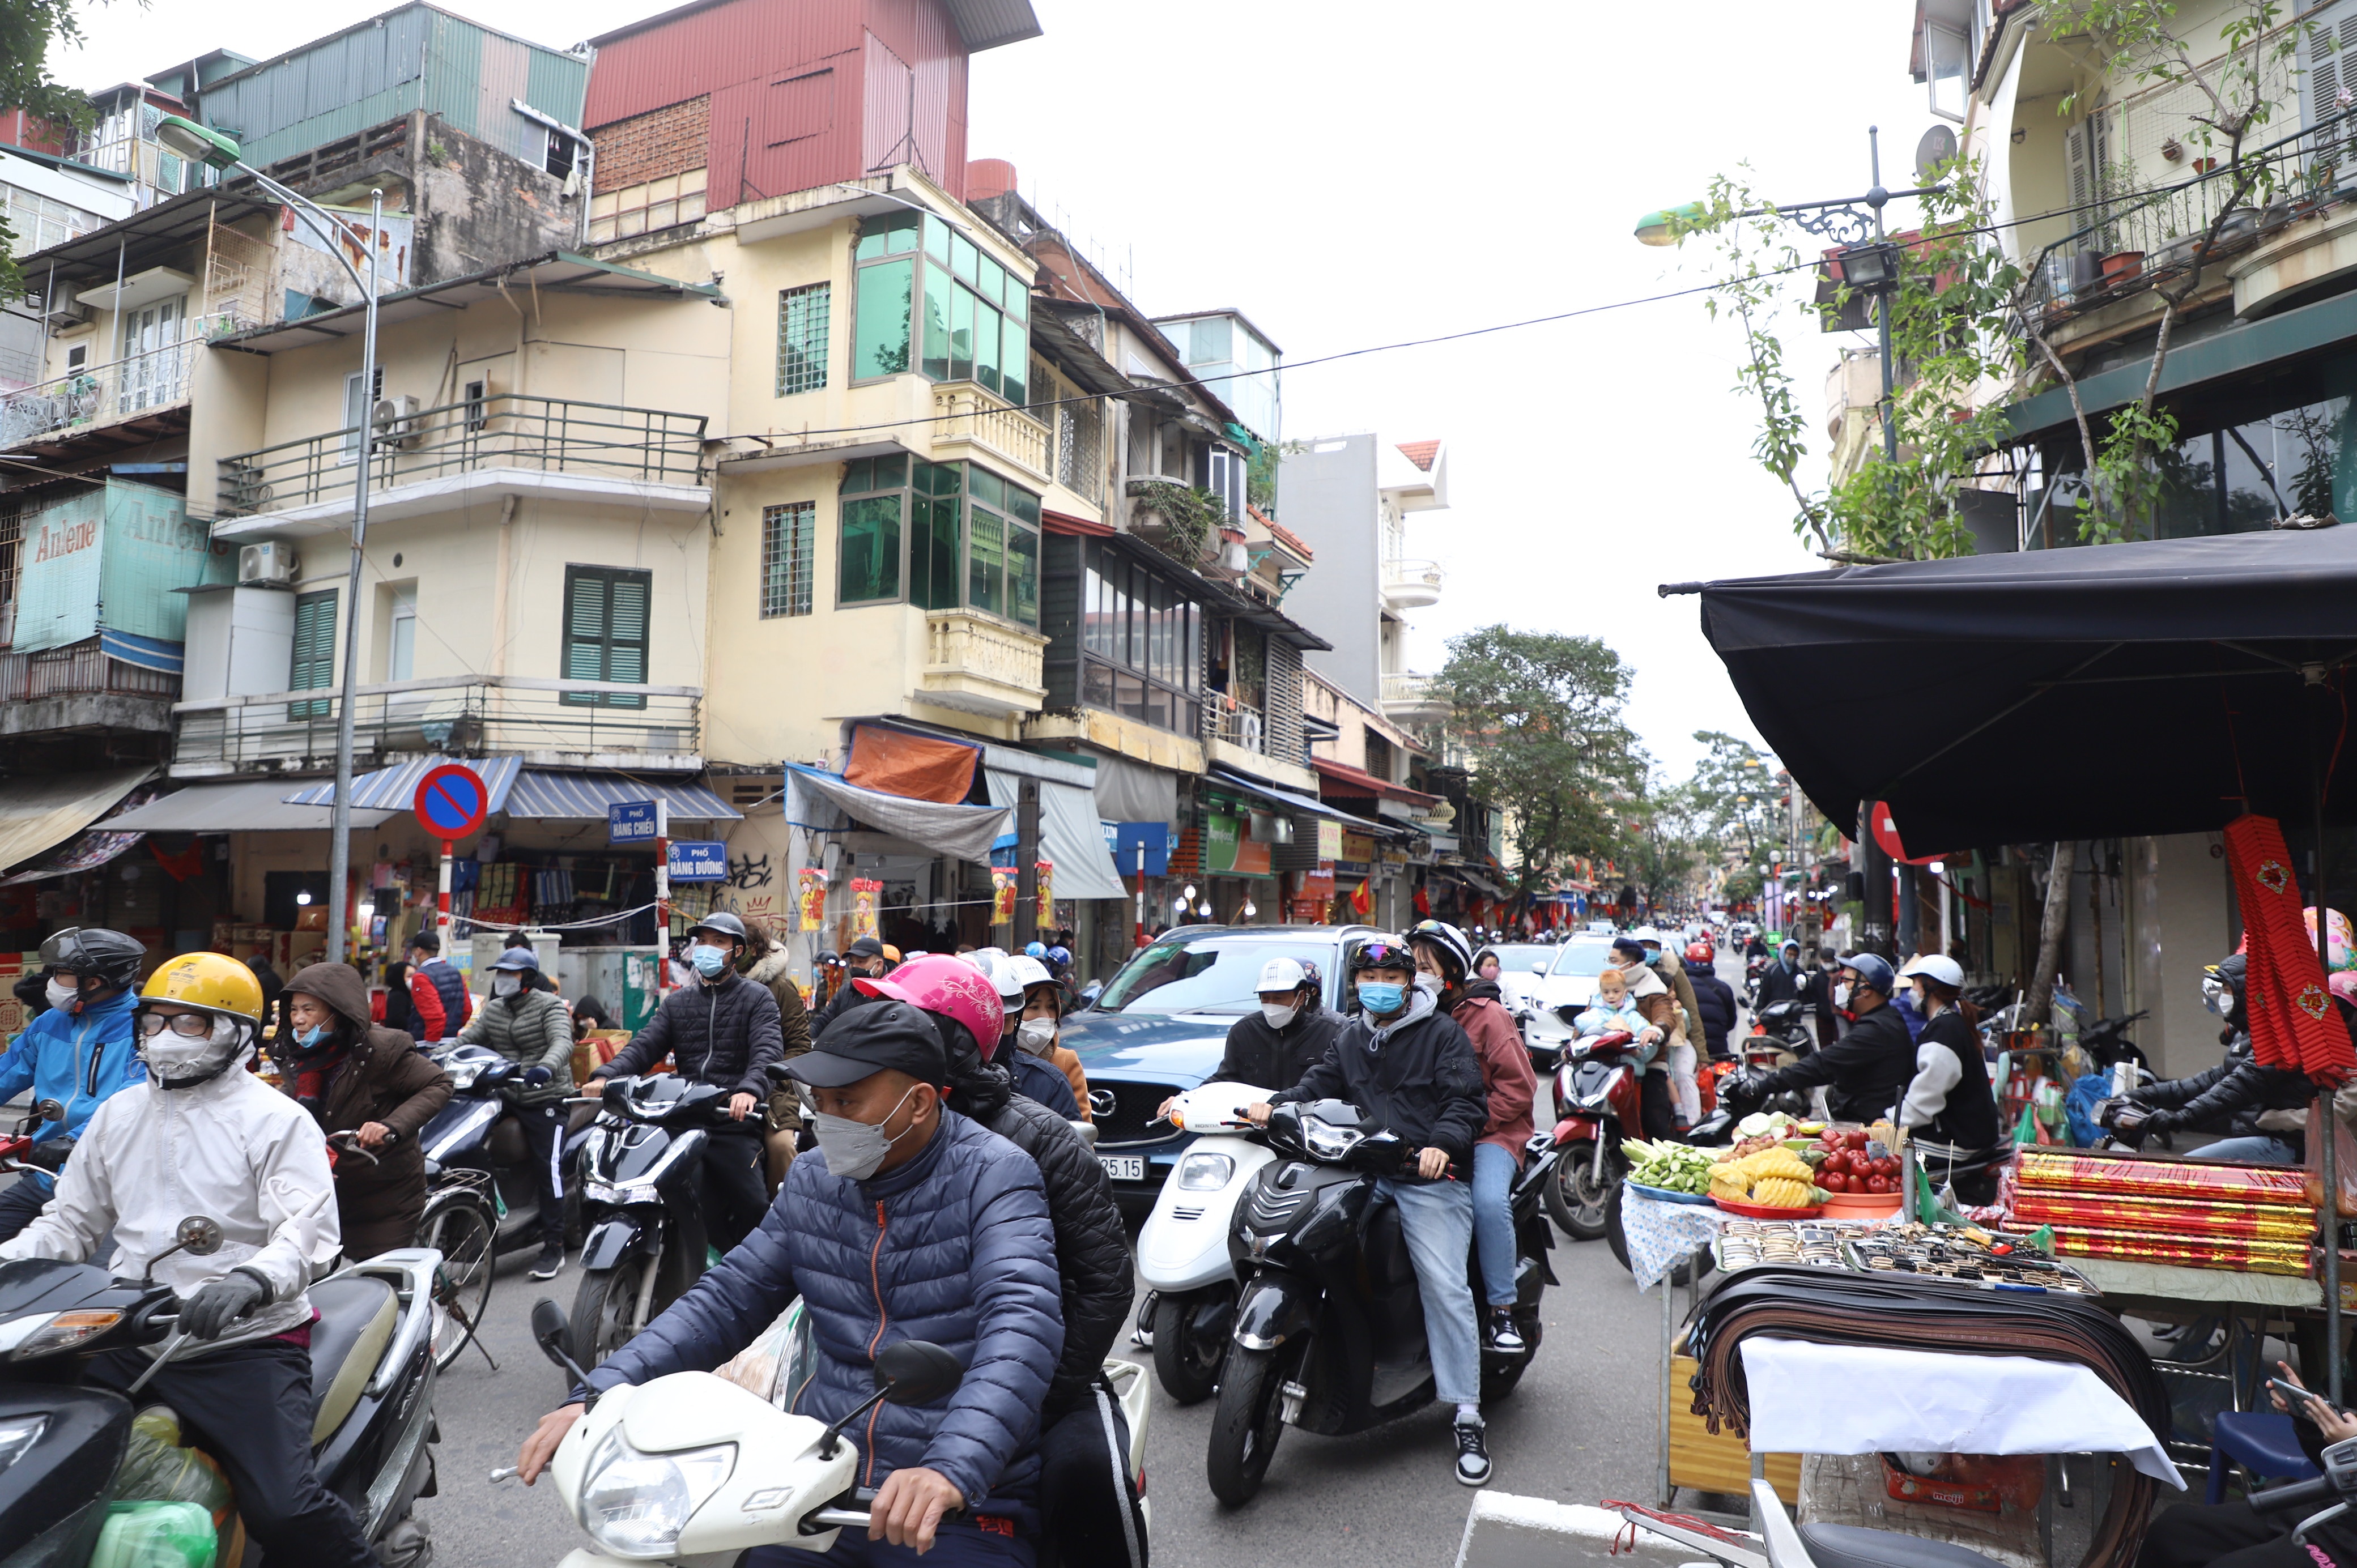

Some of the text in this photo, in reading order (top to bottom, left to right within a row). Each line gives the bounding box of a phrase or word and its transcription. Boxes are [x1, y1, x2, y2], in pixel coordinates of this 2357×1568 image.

[35, 519, 95, 563] Anlene
[629, 807, 644, 817] PHỐ
[613, 817, 654, 837] HÀNG CHIẾU
[691, 846, 709, 857] PHỐ
[670, 858, 694, 875] HÀNG
[695, 858, 724, 875] ĐƯỜNG
[1933, 1492, 1964, 1505] meiji
